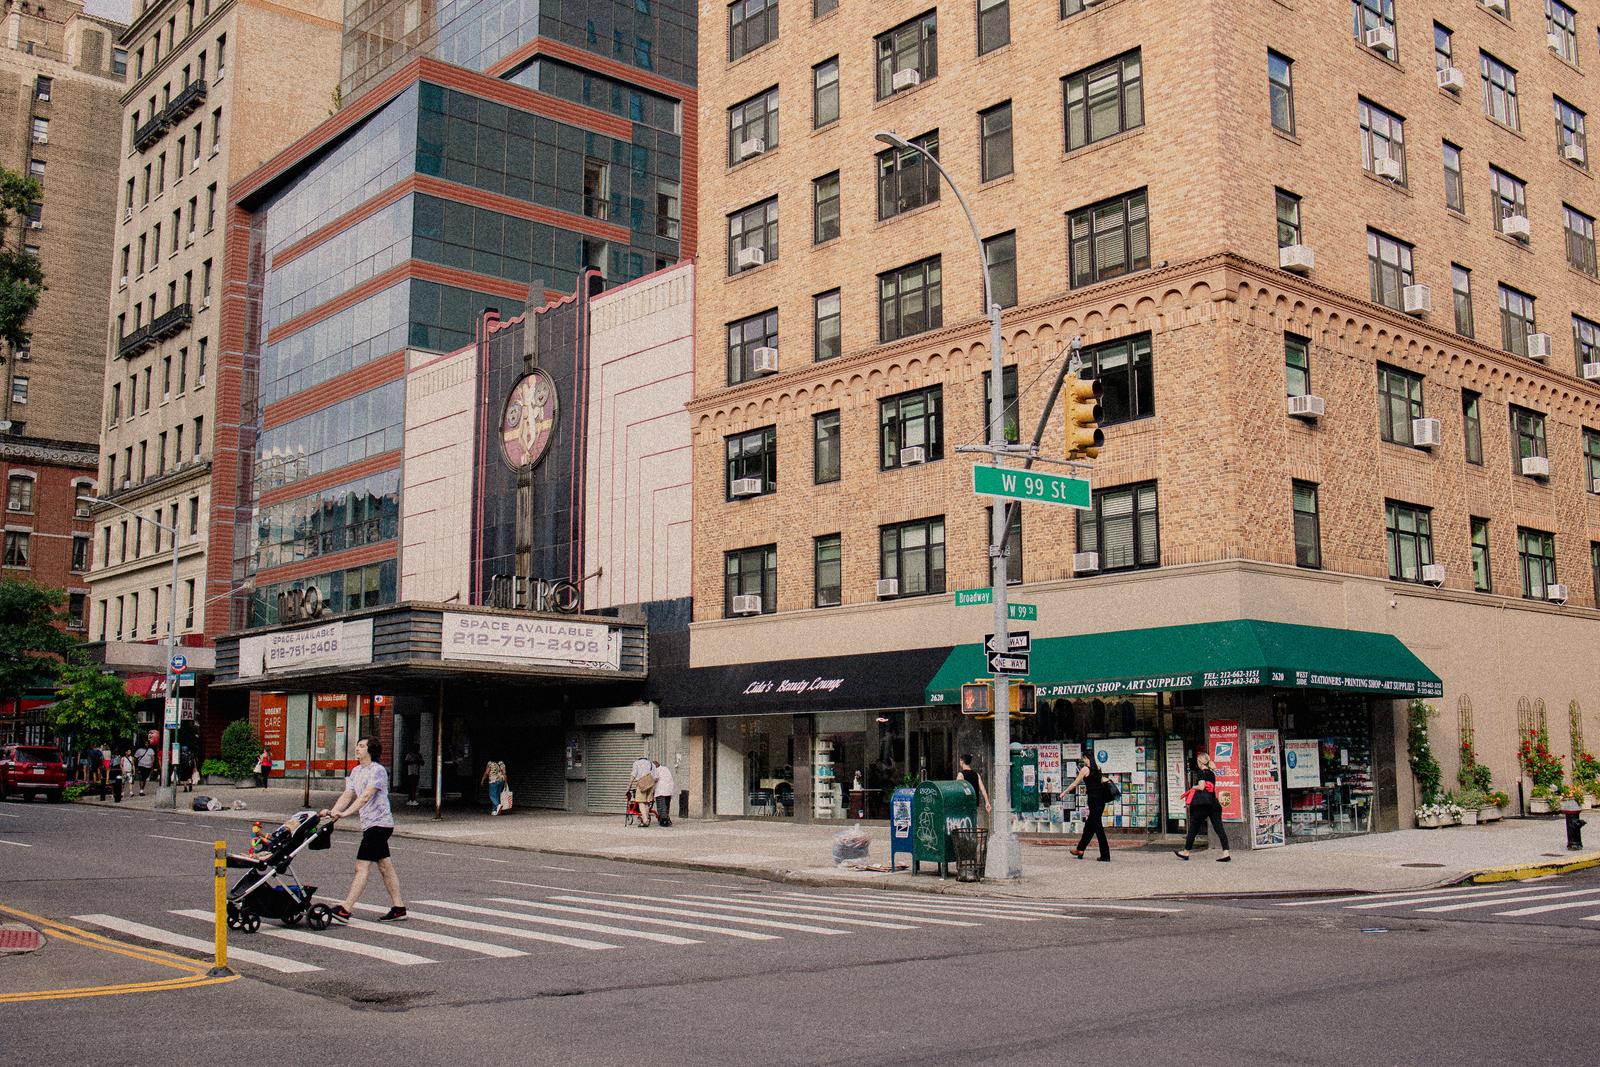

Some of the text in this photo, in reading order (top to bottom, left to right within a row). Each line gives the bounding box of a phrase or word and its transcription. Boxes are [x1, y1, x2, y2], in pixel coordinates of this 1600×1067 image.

[1002, 474, 1066, 499] W 99 St
[486, 574, 580, 614] METRO
[959, 592, 990, 604] Broadway
[1009, 606, 1016, 617] W
[1018, 606, 1027, 617] 99
[460, 619, 593, 637] SPACE AVAILABLE
[273, 628, 335, 644] SPACE AVAILABLE
[453, 631, 599, 653] 212-751-2408
[1009, 637, 1024, 646] WAY
[271, 640, 338, 659] 212-751-2408
[994, 658, 1024, 667] ONE WAY
[1204, 672, 1219, 680] TEL:
[1204, 679, 1219, 687] FAX:
[1272, 672, 1284, 681] 2620
[1310, 675, 1415, 691] STATIONERS PRINTING SHOP ART SUPPLIES
[776, 679, 809, 694] Beauty
[807, 677, 845, 692] Lounge
[1053, 684, 1095, 696] PRINTING
[1095, 681, 1121, 693] SHOP
[1125, 680, 1143, 690] ART
[1144, 676, 1192, 689] SUPPLIES
[930, 694, 944, 702] 2620
[264, 717, 281, 727] CARE
